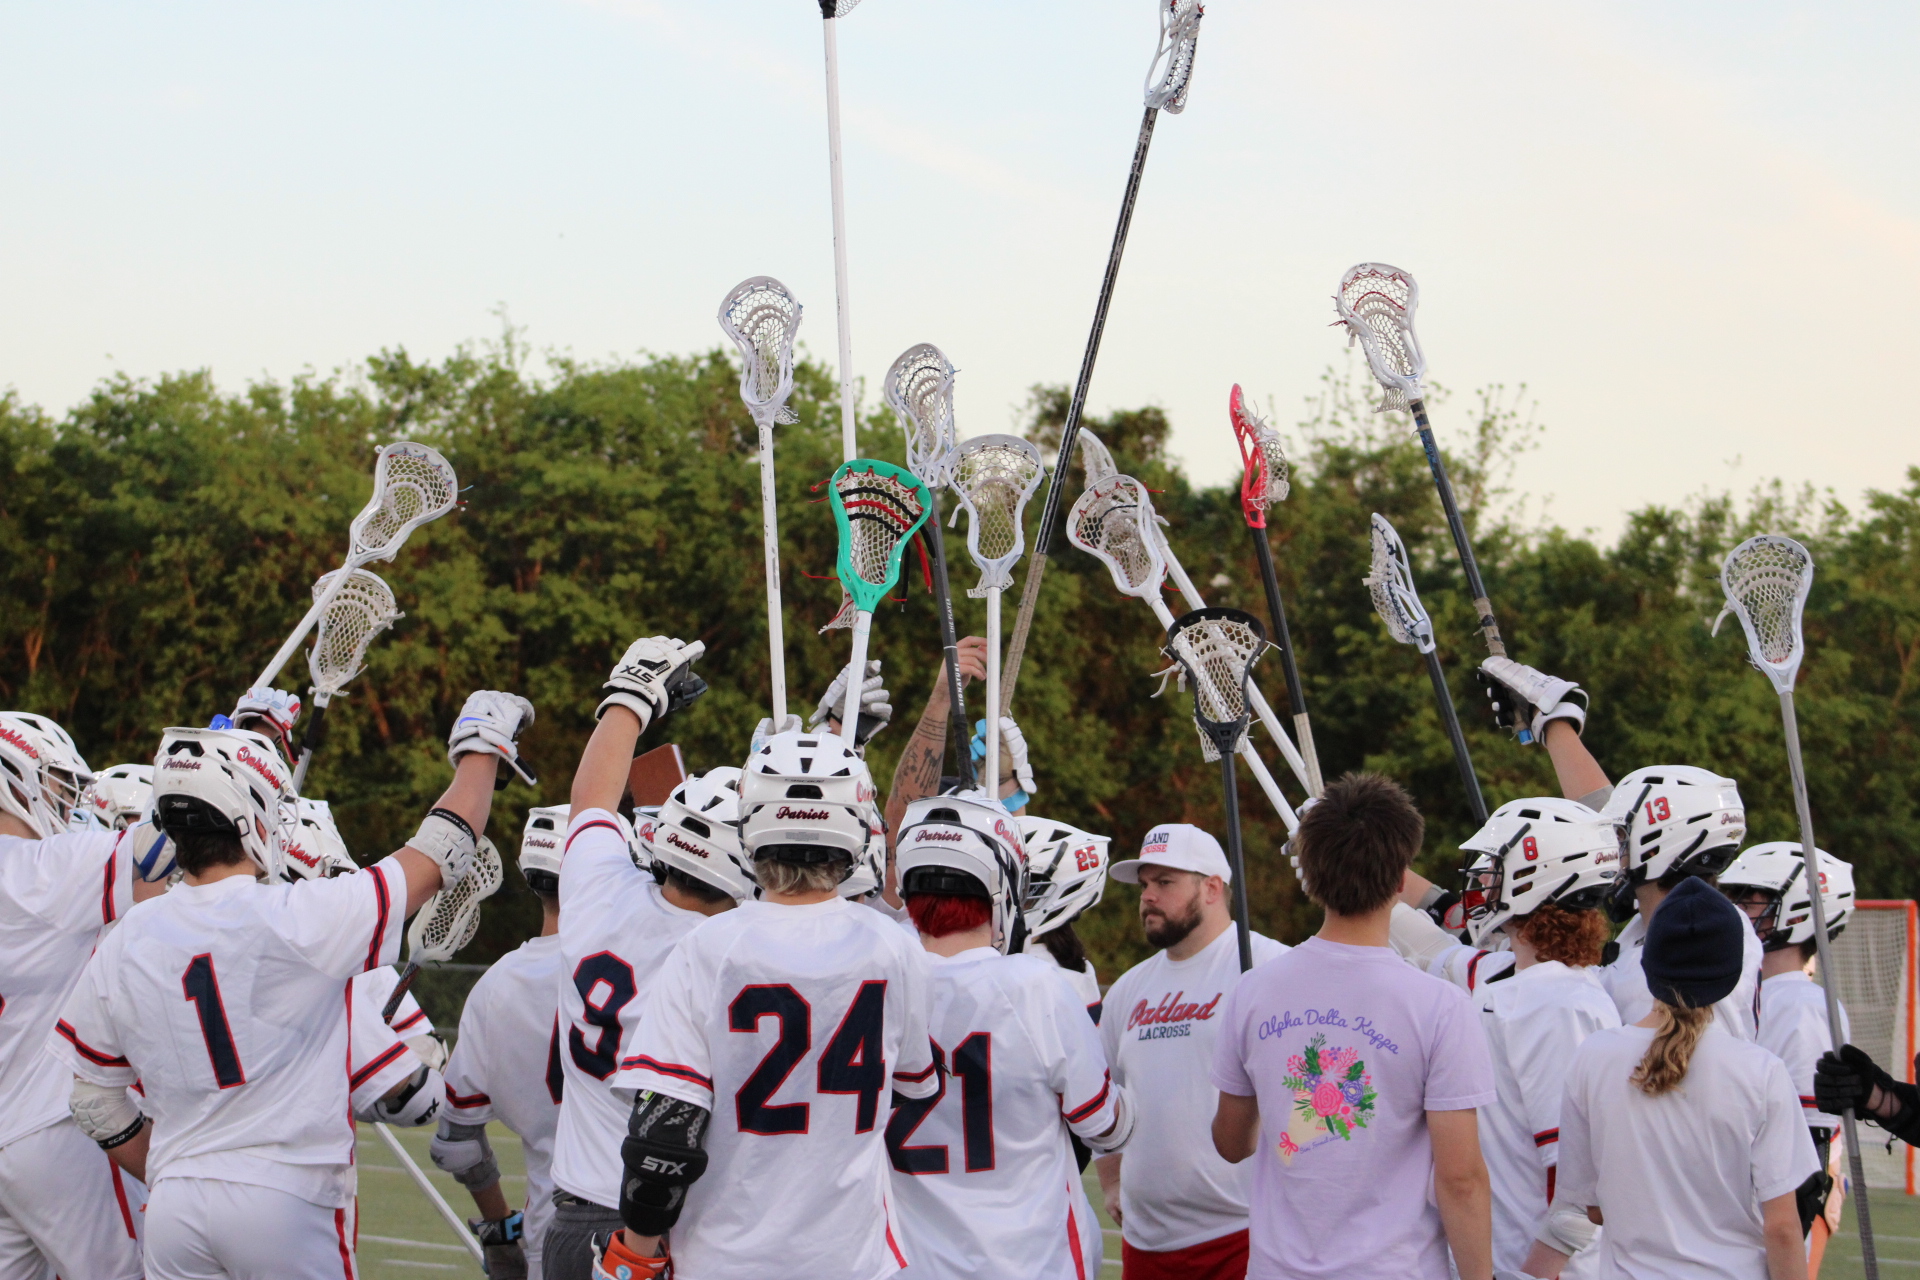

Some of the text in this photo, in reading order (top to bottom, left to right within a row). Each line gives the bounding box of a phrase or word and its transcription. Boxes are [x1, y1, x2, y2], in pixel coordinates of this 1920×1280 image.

[620, 665, 656, 683] STX
[954, 663, 964, 707] SIGNATURE
[162, 757, 202, 770] Patriots
[776, 806, 829, 820] Patriots
[1645, 796, 1671, 825] 13
[524, 835, 556, 849] Patriots
[666, 832, 710, 858] Patriots
[915, 829, 963, 842] Patriots
[1522, 836, 1538, 861] 8
[1074, 845, 1099, 872] 25
[182, 952, 246, 1089] 1
[568, 950, 637, 1081] 9
[1127, 991, 1223, 1031] Oakland
[1138, 1023, 1191, 1041] LACROSSE
[1258, 1008, 1399, 1055] Alpha Delta Kappa
[728, 979, 888, 1136] 24
[884, 1031, 995, 1175] 21
[641, 1155, 688, 1175] STX
